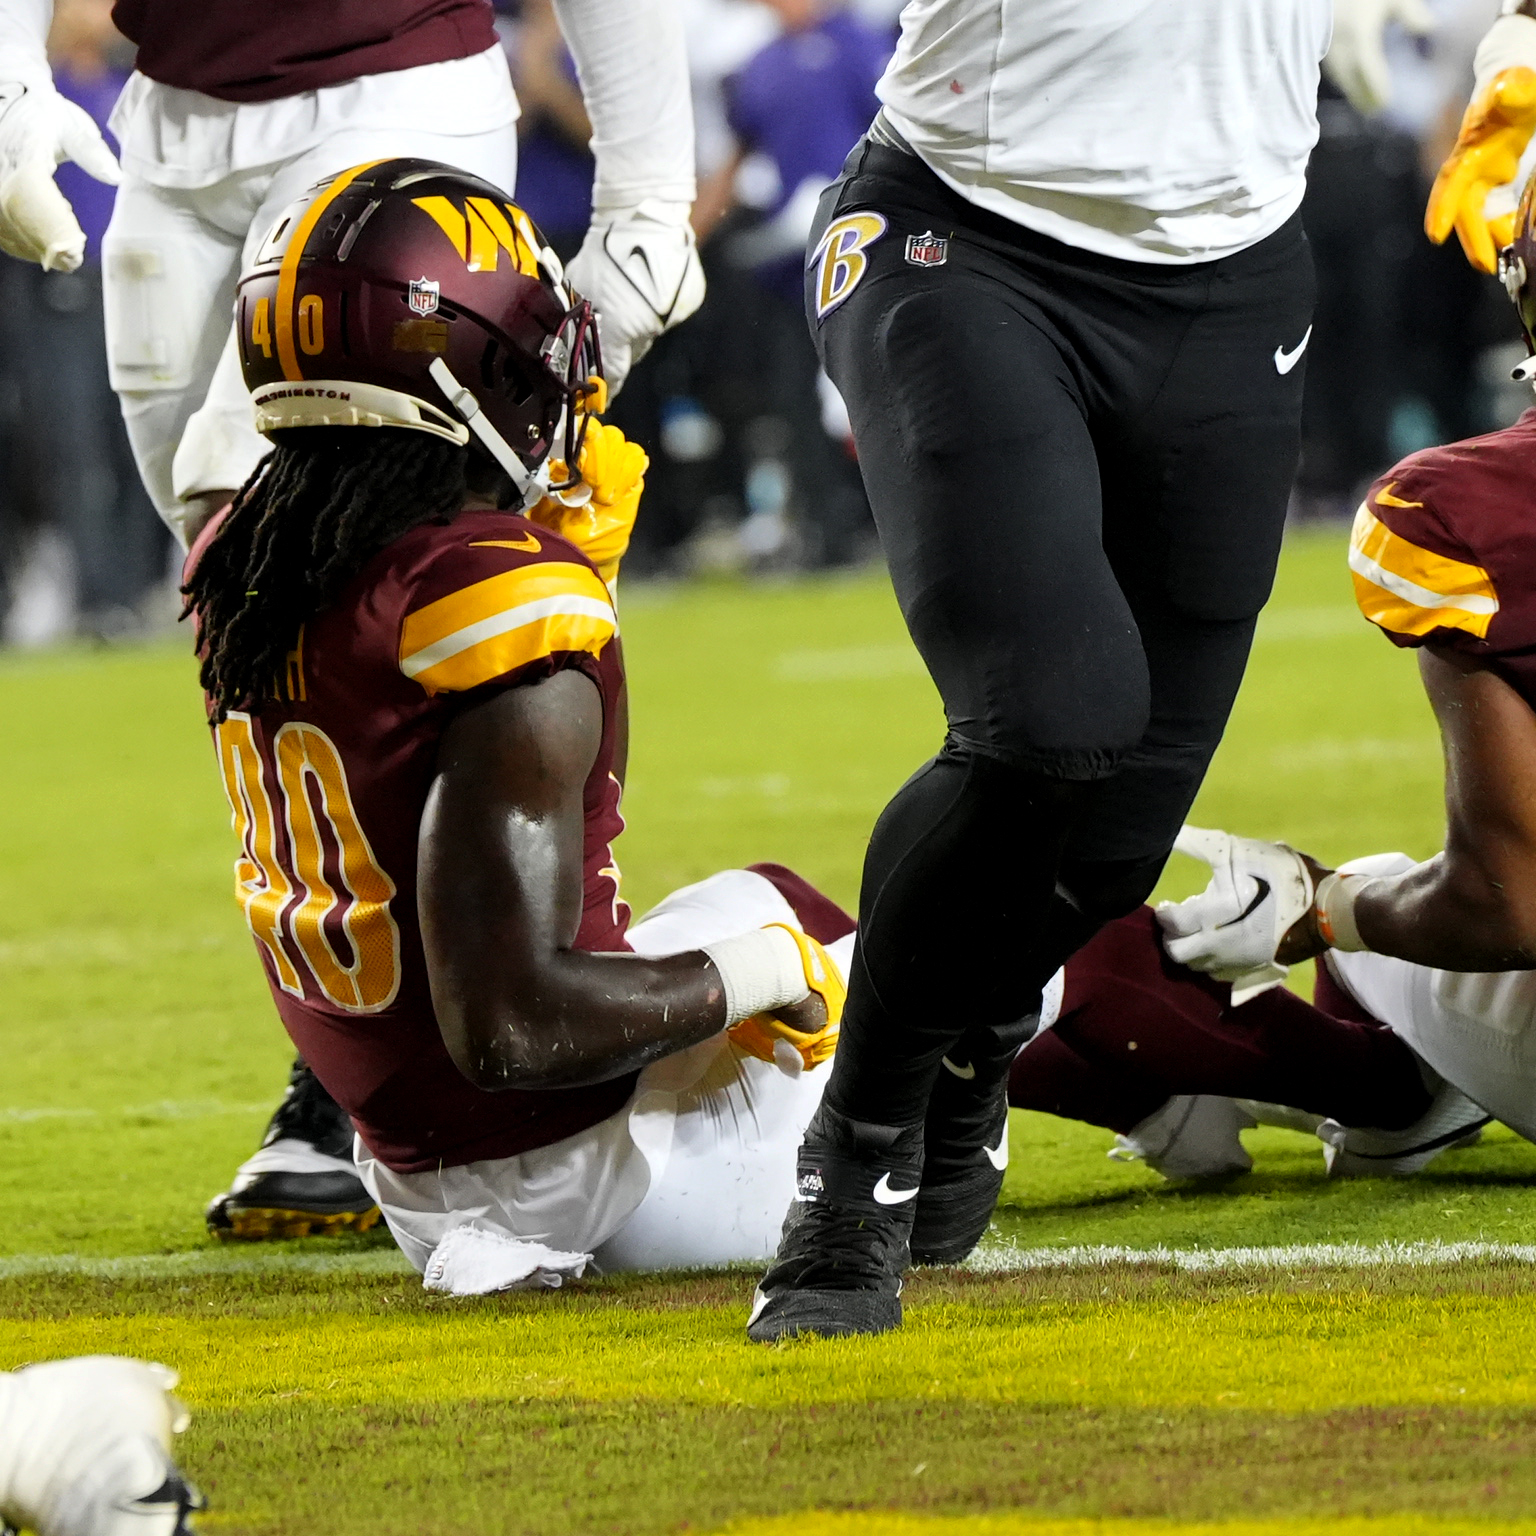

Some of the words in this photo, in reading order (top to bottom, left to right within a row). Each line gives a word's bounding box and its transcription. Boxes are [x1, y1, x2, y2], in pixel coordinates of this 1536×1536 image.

[911, 245, 943, 263] NFL
[412, 293, 435, 309] NFL
[215, 709, 402, 1014] 40
